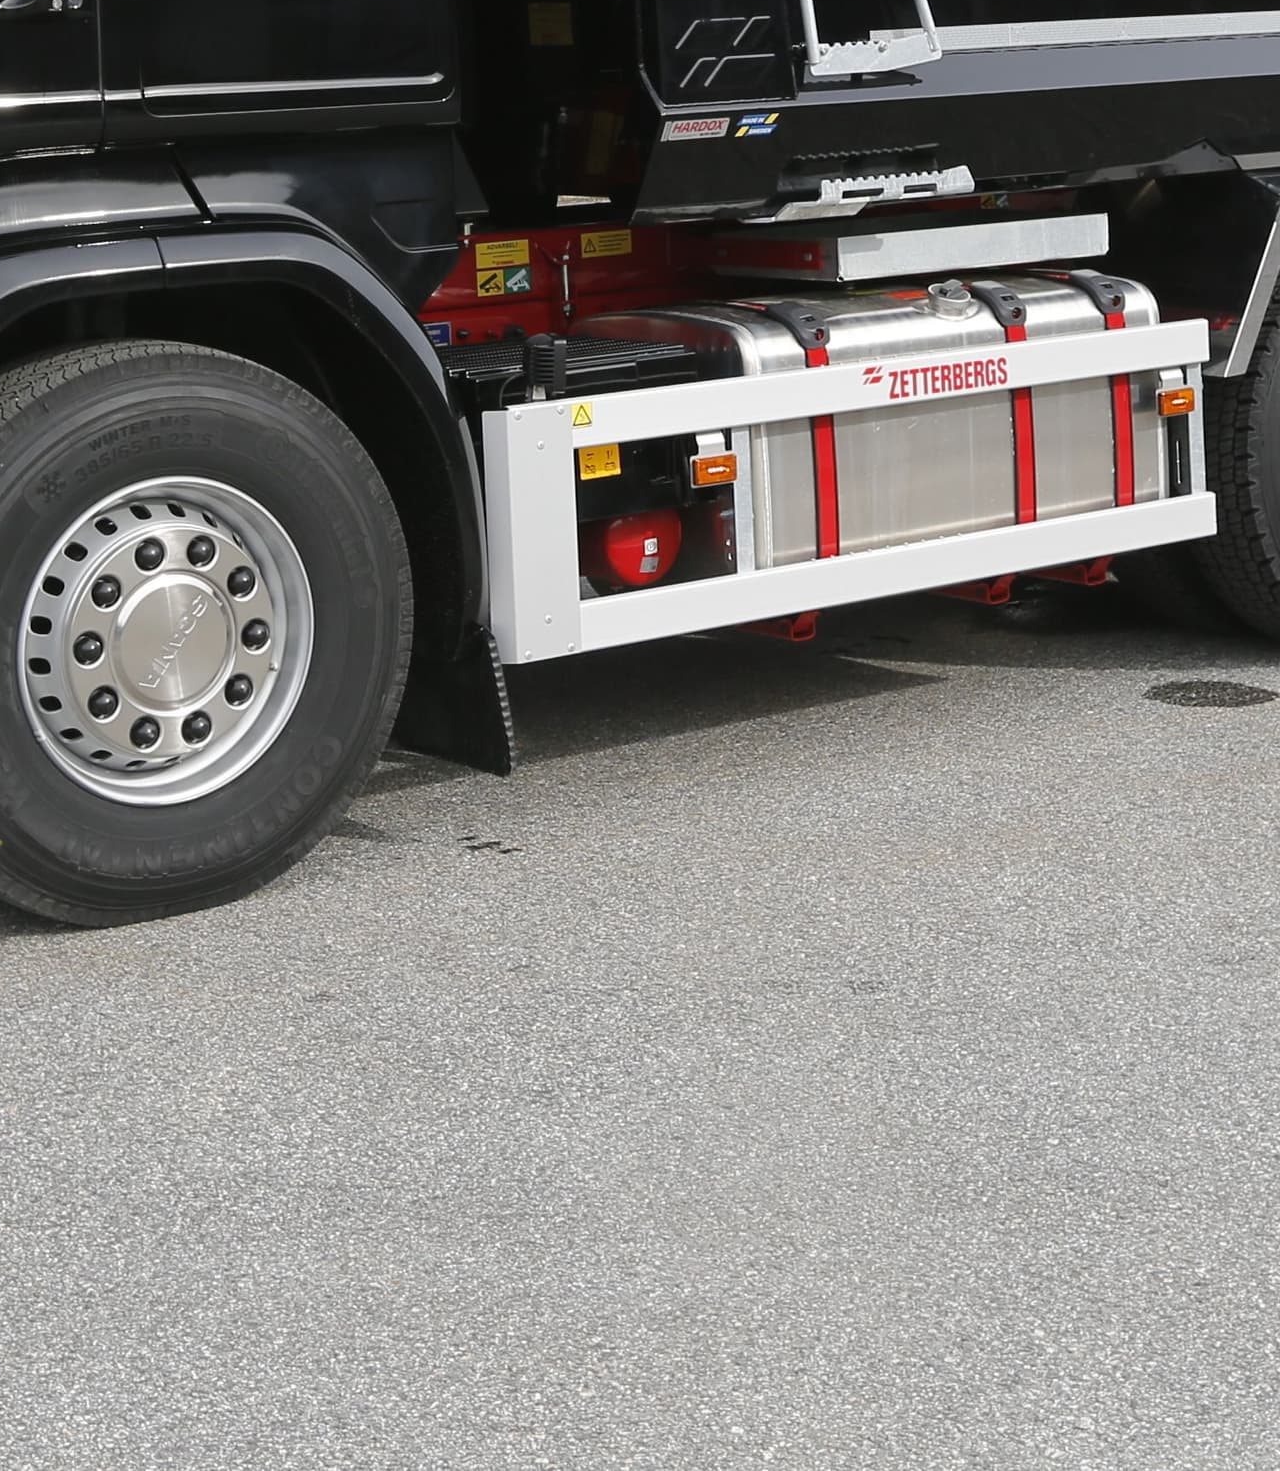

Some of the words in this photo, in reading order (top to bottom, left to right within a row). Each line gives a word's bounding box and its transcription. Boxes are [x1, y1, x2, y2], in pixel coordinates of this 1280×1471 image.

[671, 120, 725, 134] HARDOX
[888, 357, 1008, 399] ZETTERBERGS
[87, 419, 153, 451] WINTER
[137, 594, 209, 688] SCANIA
